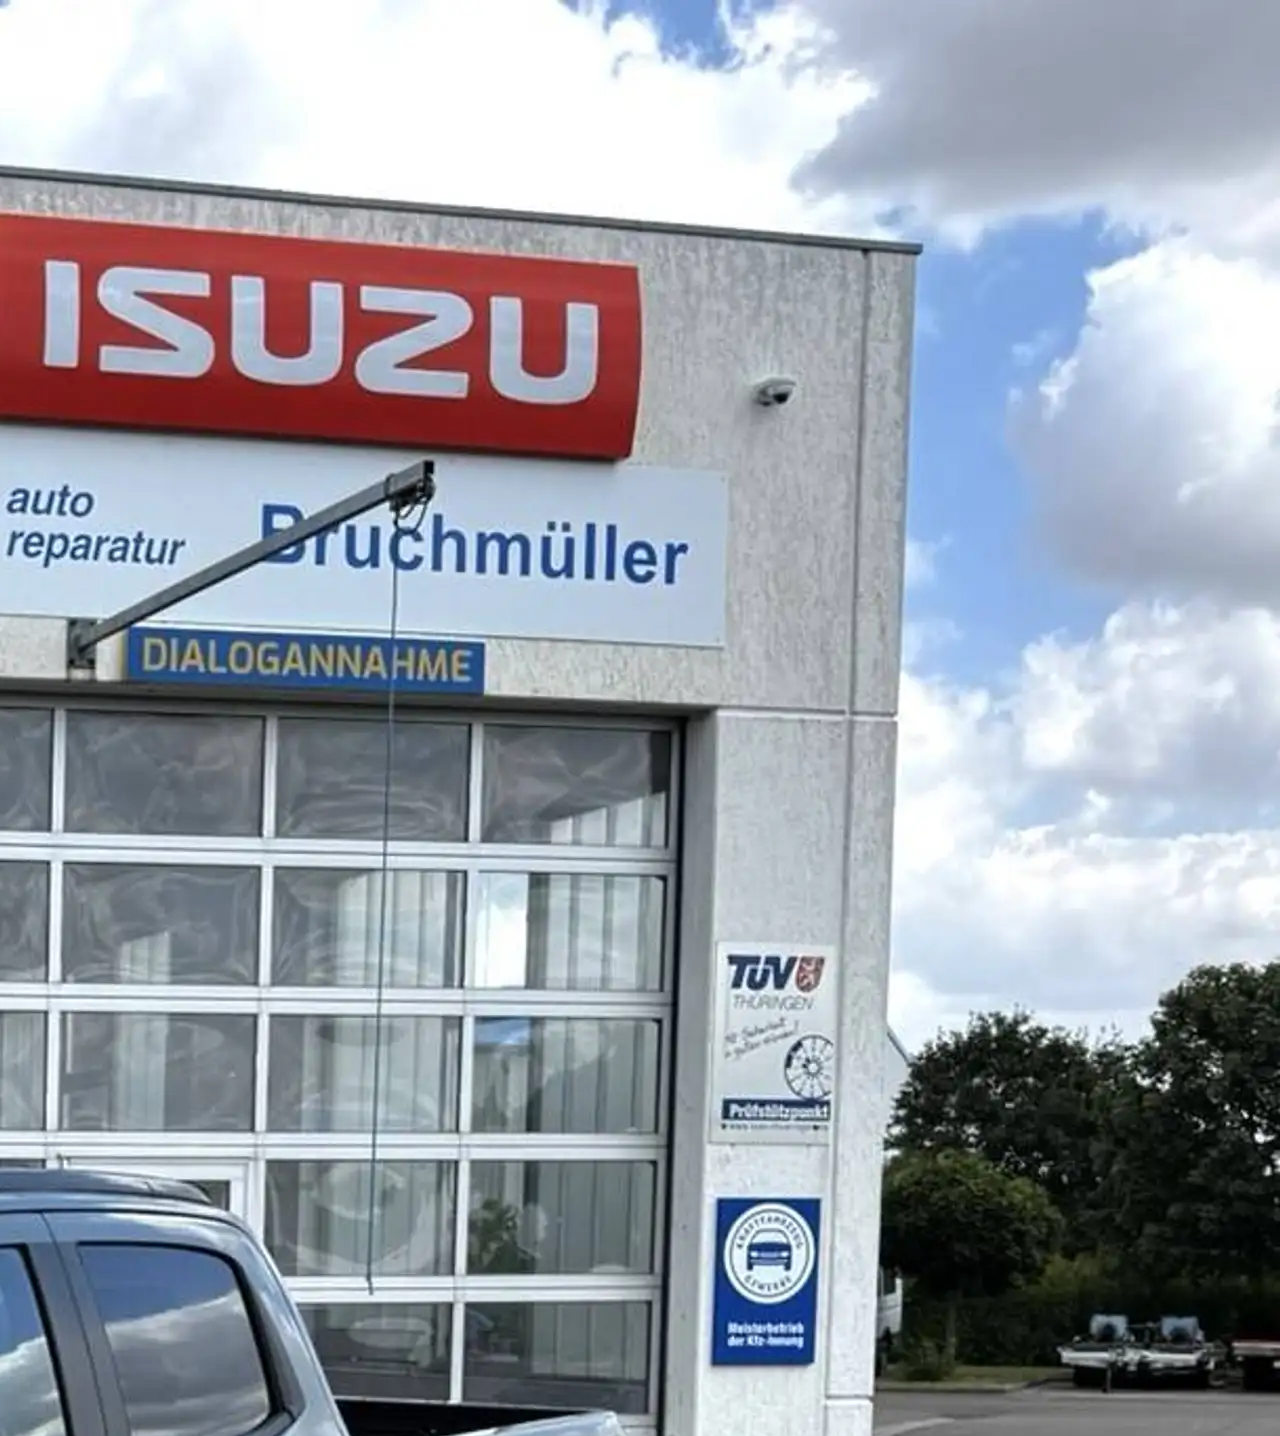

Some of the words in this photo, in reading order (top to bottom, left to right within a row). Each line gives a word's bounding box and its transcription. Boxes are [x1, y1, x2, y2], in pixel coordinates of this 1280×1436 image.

[42, 259, 600, 405] ISUZU
[5, 482, 94, 519] auto
[6, 524, 187, 568] reparatur
[261, 502, 690, 586] Bruchmüller
[141, 637, 472, 683] DIALOGANNAHME
[727, 954, 796, 990] TÜV
[733, 994, 815, 1011] THÜRINGEN
